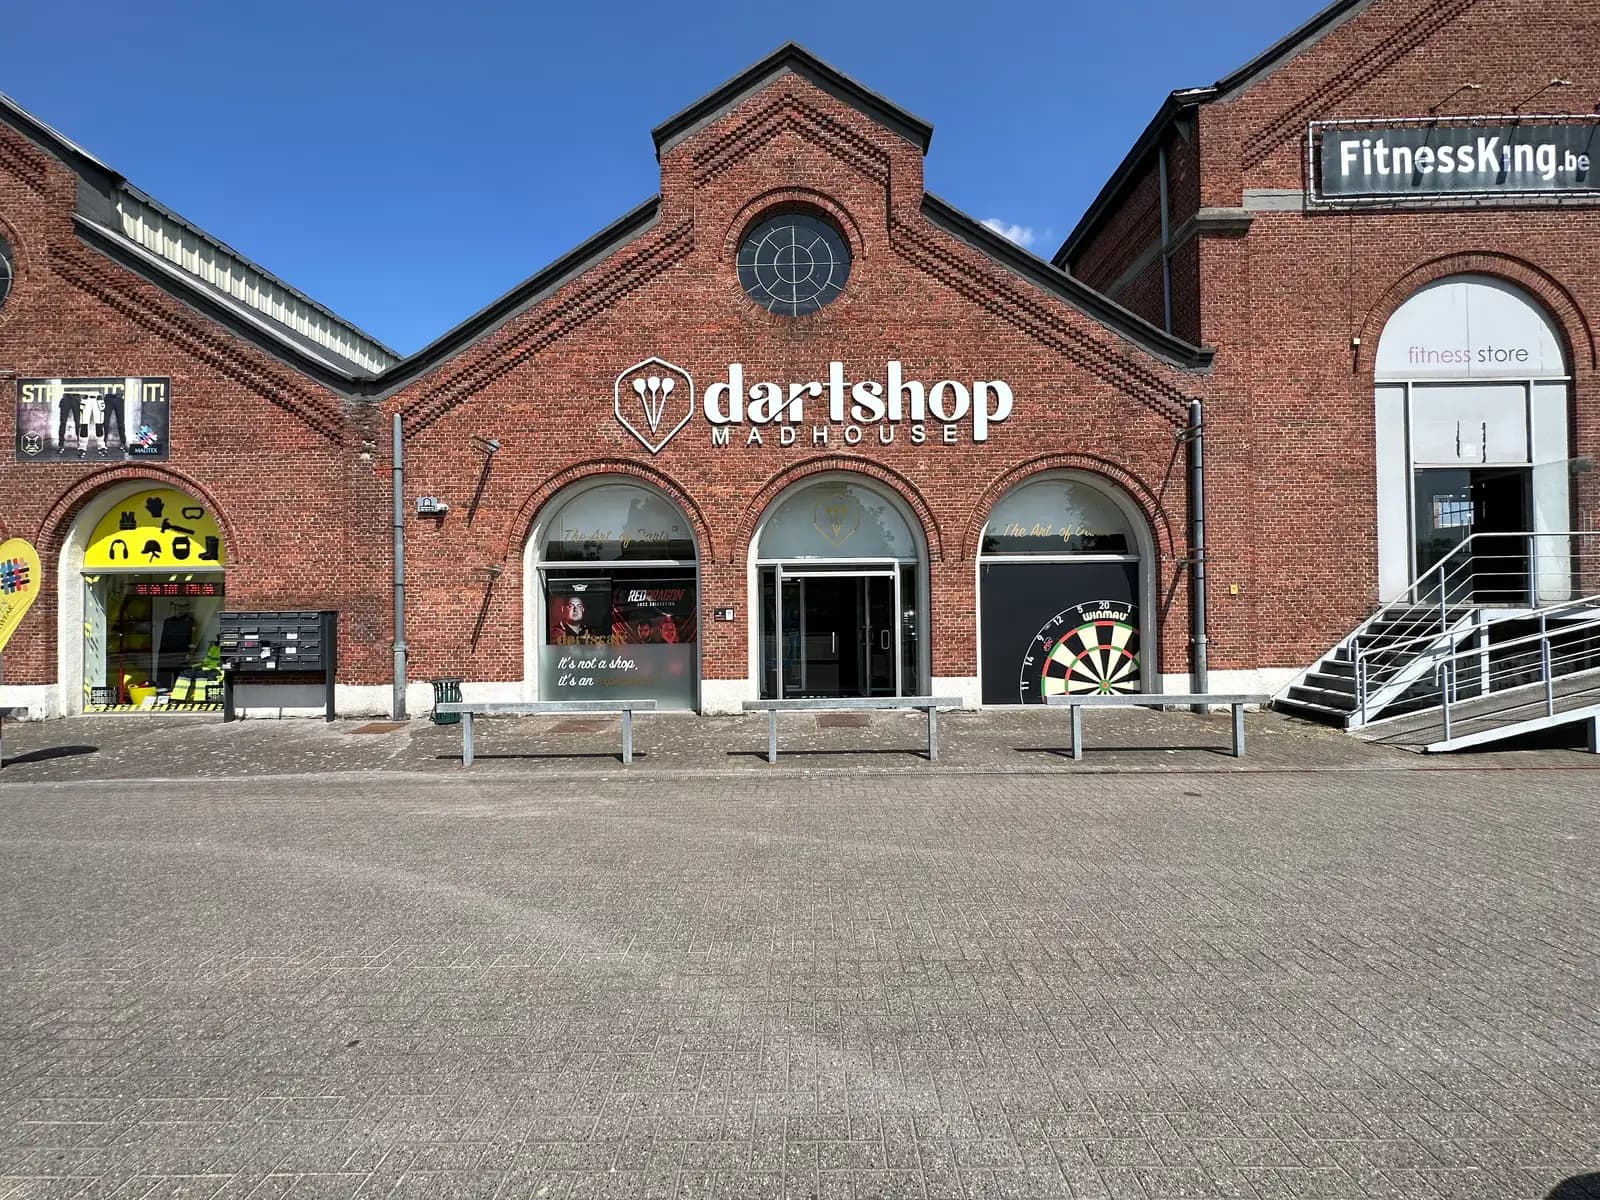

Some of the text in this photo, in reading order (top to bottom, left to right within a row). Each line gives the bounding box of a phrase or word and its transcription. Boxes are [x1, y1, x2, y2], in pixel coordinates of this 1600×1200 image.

[1340, 136, 1590, 180] FitnessKing.be
[1408, 345, 1529, 364] fitness store
[143, 383, 165, 402] IT!
[703, 361, 1013, 441] dartshop
[712, 425, 959, 445] MADHOUSE
[565, 528, 586, 544] The
[591, 528, 612, 544] Art
[1003, 522, 1026, 537] The
[1030, 522, 1054, 537] Art
[1059, 524, 1073, 543] of
[1077, 605, 1084, 614] 5
[1099, 601, 1110, 610] 20
[1127, 604, 1132, 613] 1
[1053, 615, 1064, 626] 12
[1082, 610, 1129, 621] WINMAU
[1036, 634, 1045, 643] 9
[557, 656, 576, 669] It's
[577, 656, 597, 669] not
[598, 660, 607, 669] a
[1024, 656, 1035, 666] 14
[557, 673, 577, 687] it's
[578, 676, 594, 687] an
[1021, 681, 1030, 690] 11
